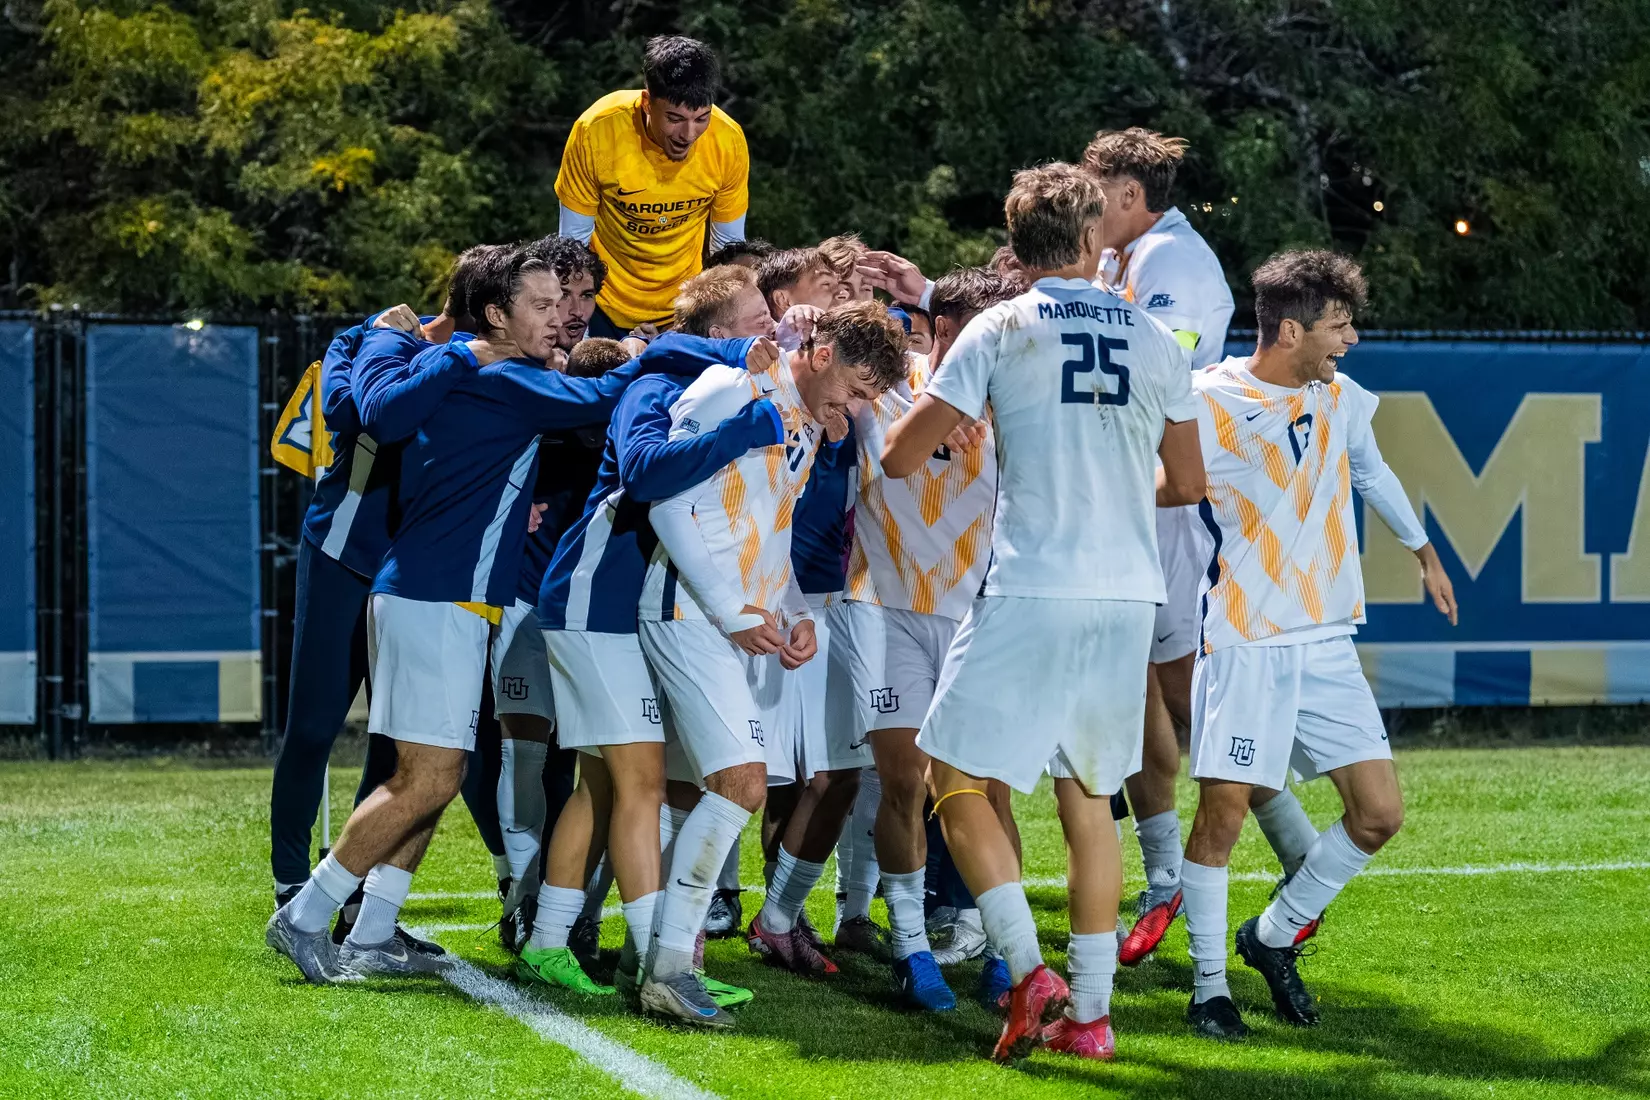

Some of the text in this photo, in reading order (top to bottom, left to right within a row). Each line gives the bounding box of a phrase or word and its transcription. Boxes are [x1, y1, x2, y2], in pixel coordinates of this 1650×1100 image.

[626, 216, 689, 234] SOCCER
[1038, 301, 1134, 326] MARQUETTE
[1061, 332, 1130, 406] 25
[1357, 391, 1650, 604] M
[501, 676, 530, 700] MU
[869, 687, 900, 714] MU
[641, 698, 662, 724] MU
[1228, 736, 1256, 767] MU
